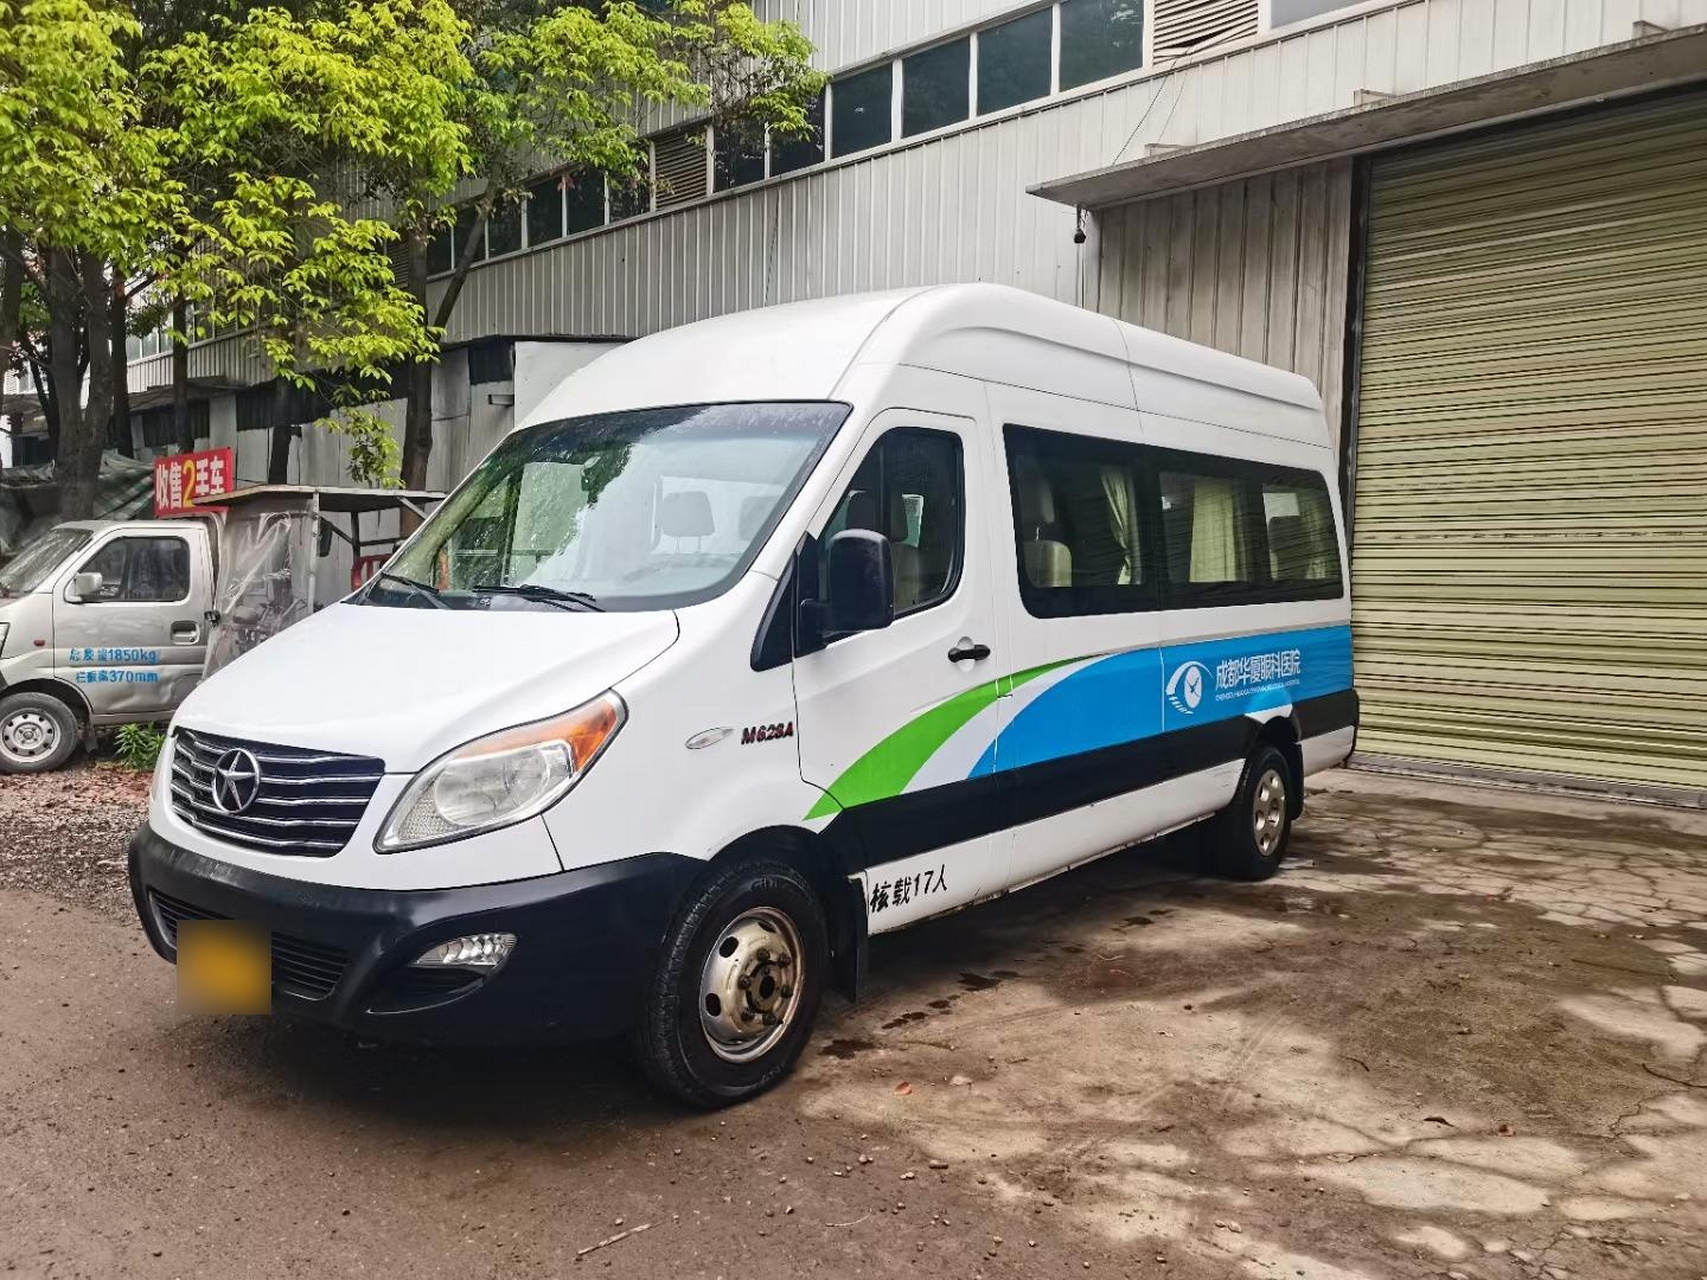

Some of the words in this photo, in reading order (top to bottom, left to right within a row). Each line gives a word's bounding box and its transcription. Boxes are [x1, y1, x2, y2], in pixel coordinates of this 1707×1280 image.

[155, 455, 225, 509] 收售2手车
[1215, 648, 1302, 690] 成都华厦眼科医院
[869, 863, 948, 913] 核载17人
